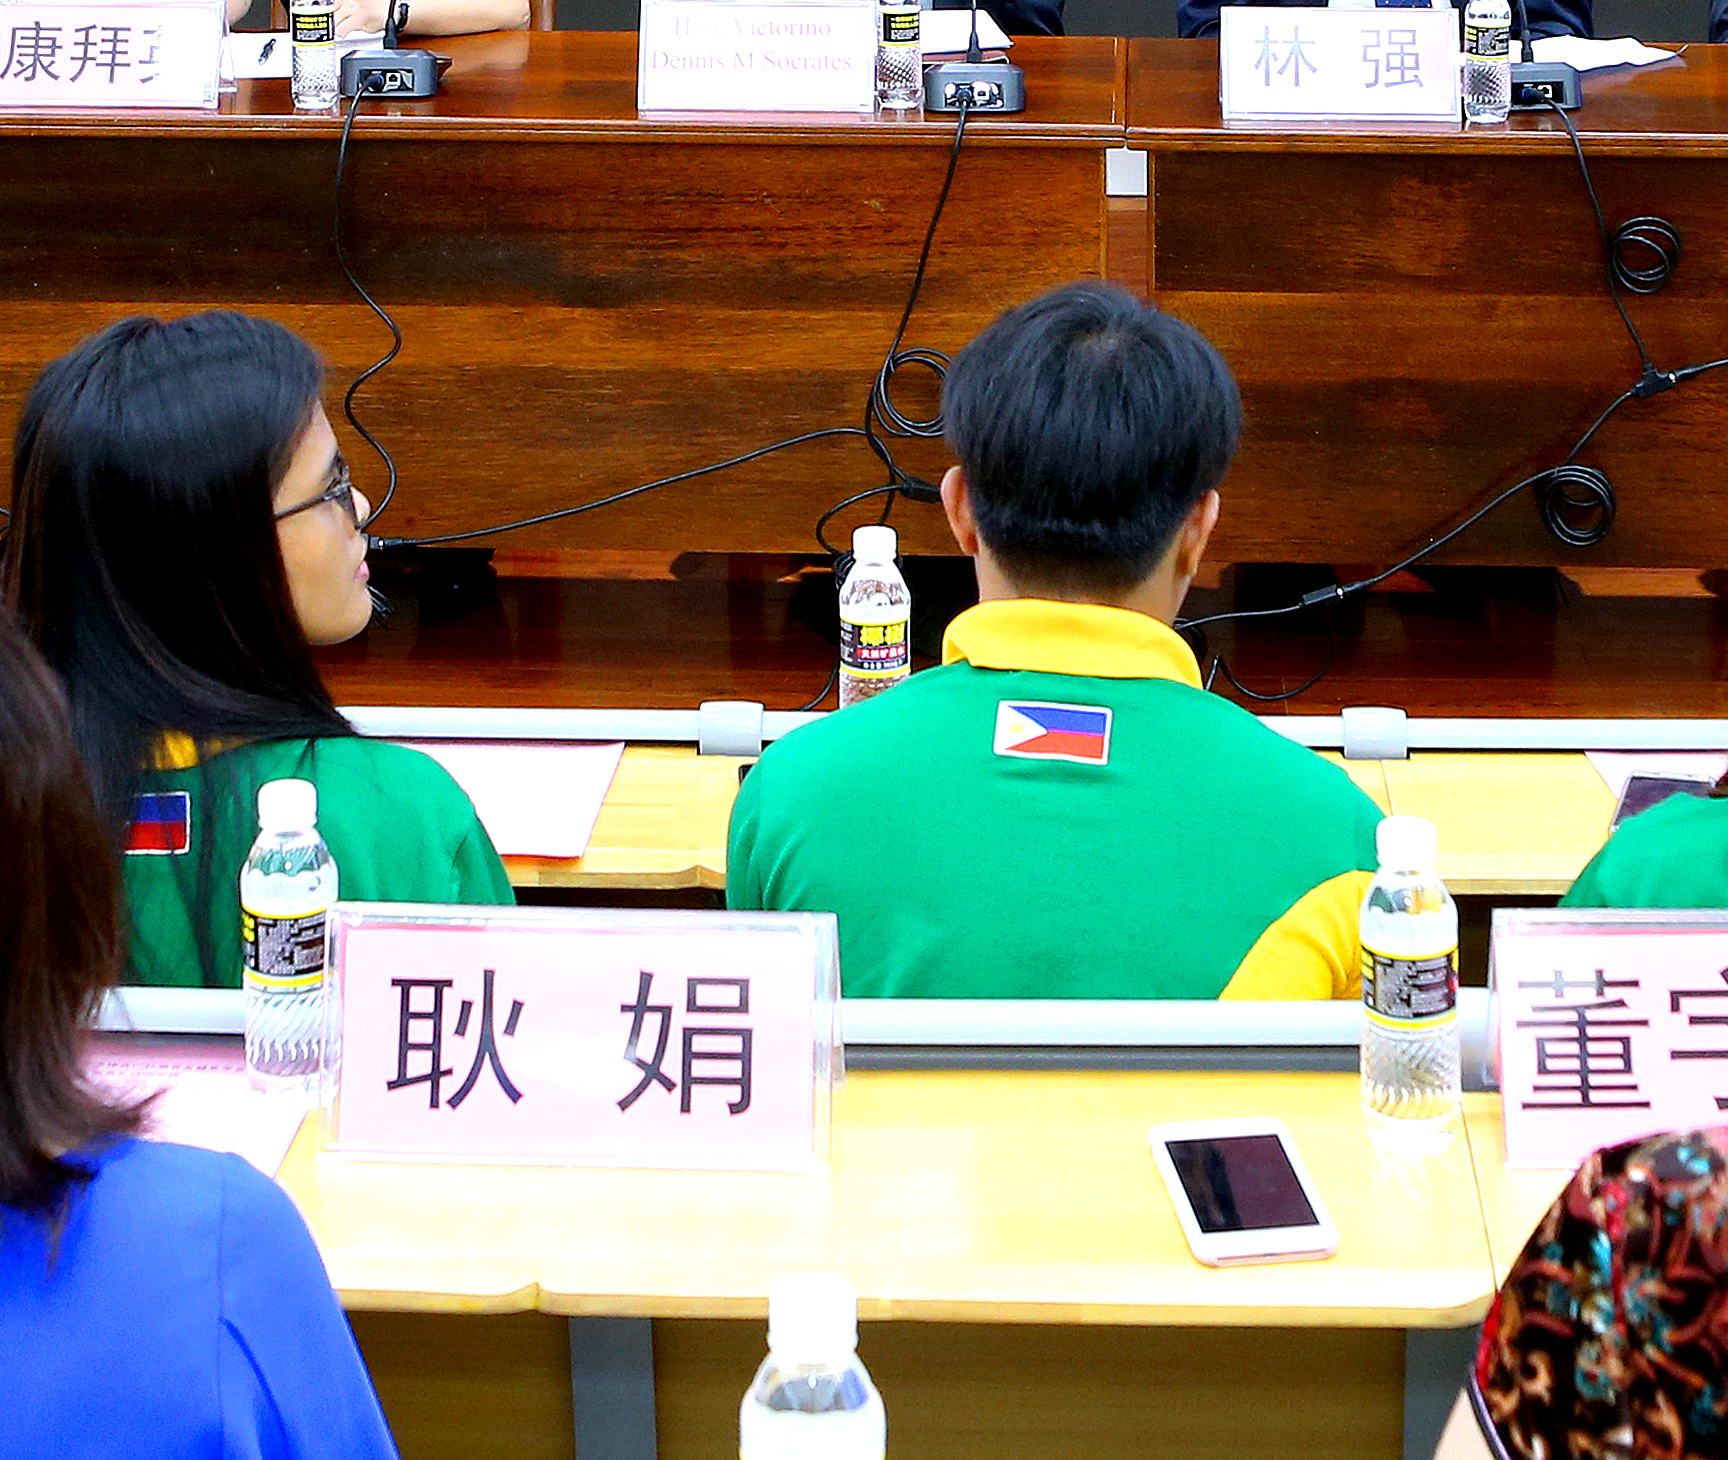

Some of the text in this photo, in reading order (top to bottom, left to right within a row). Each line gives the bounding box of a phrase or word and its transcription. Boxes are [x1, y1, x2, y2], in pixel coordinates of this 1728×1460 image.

[651, 50, 853, 71] Dennis M Socrates
